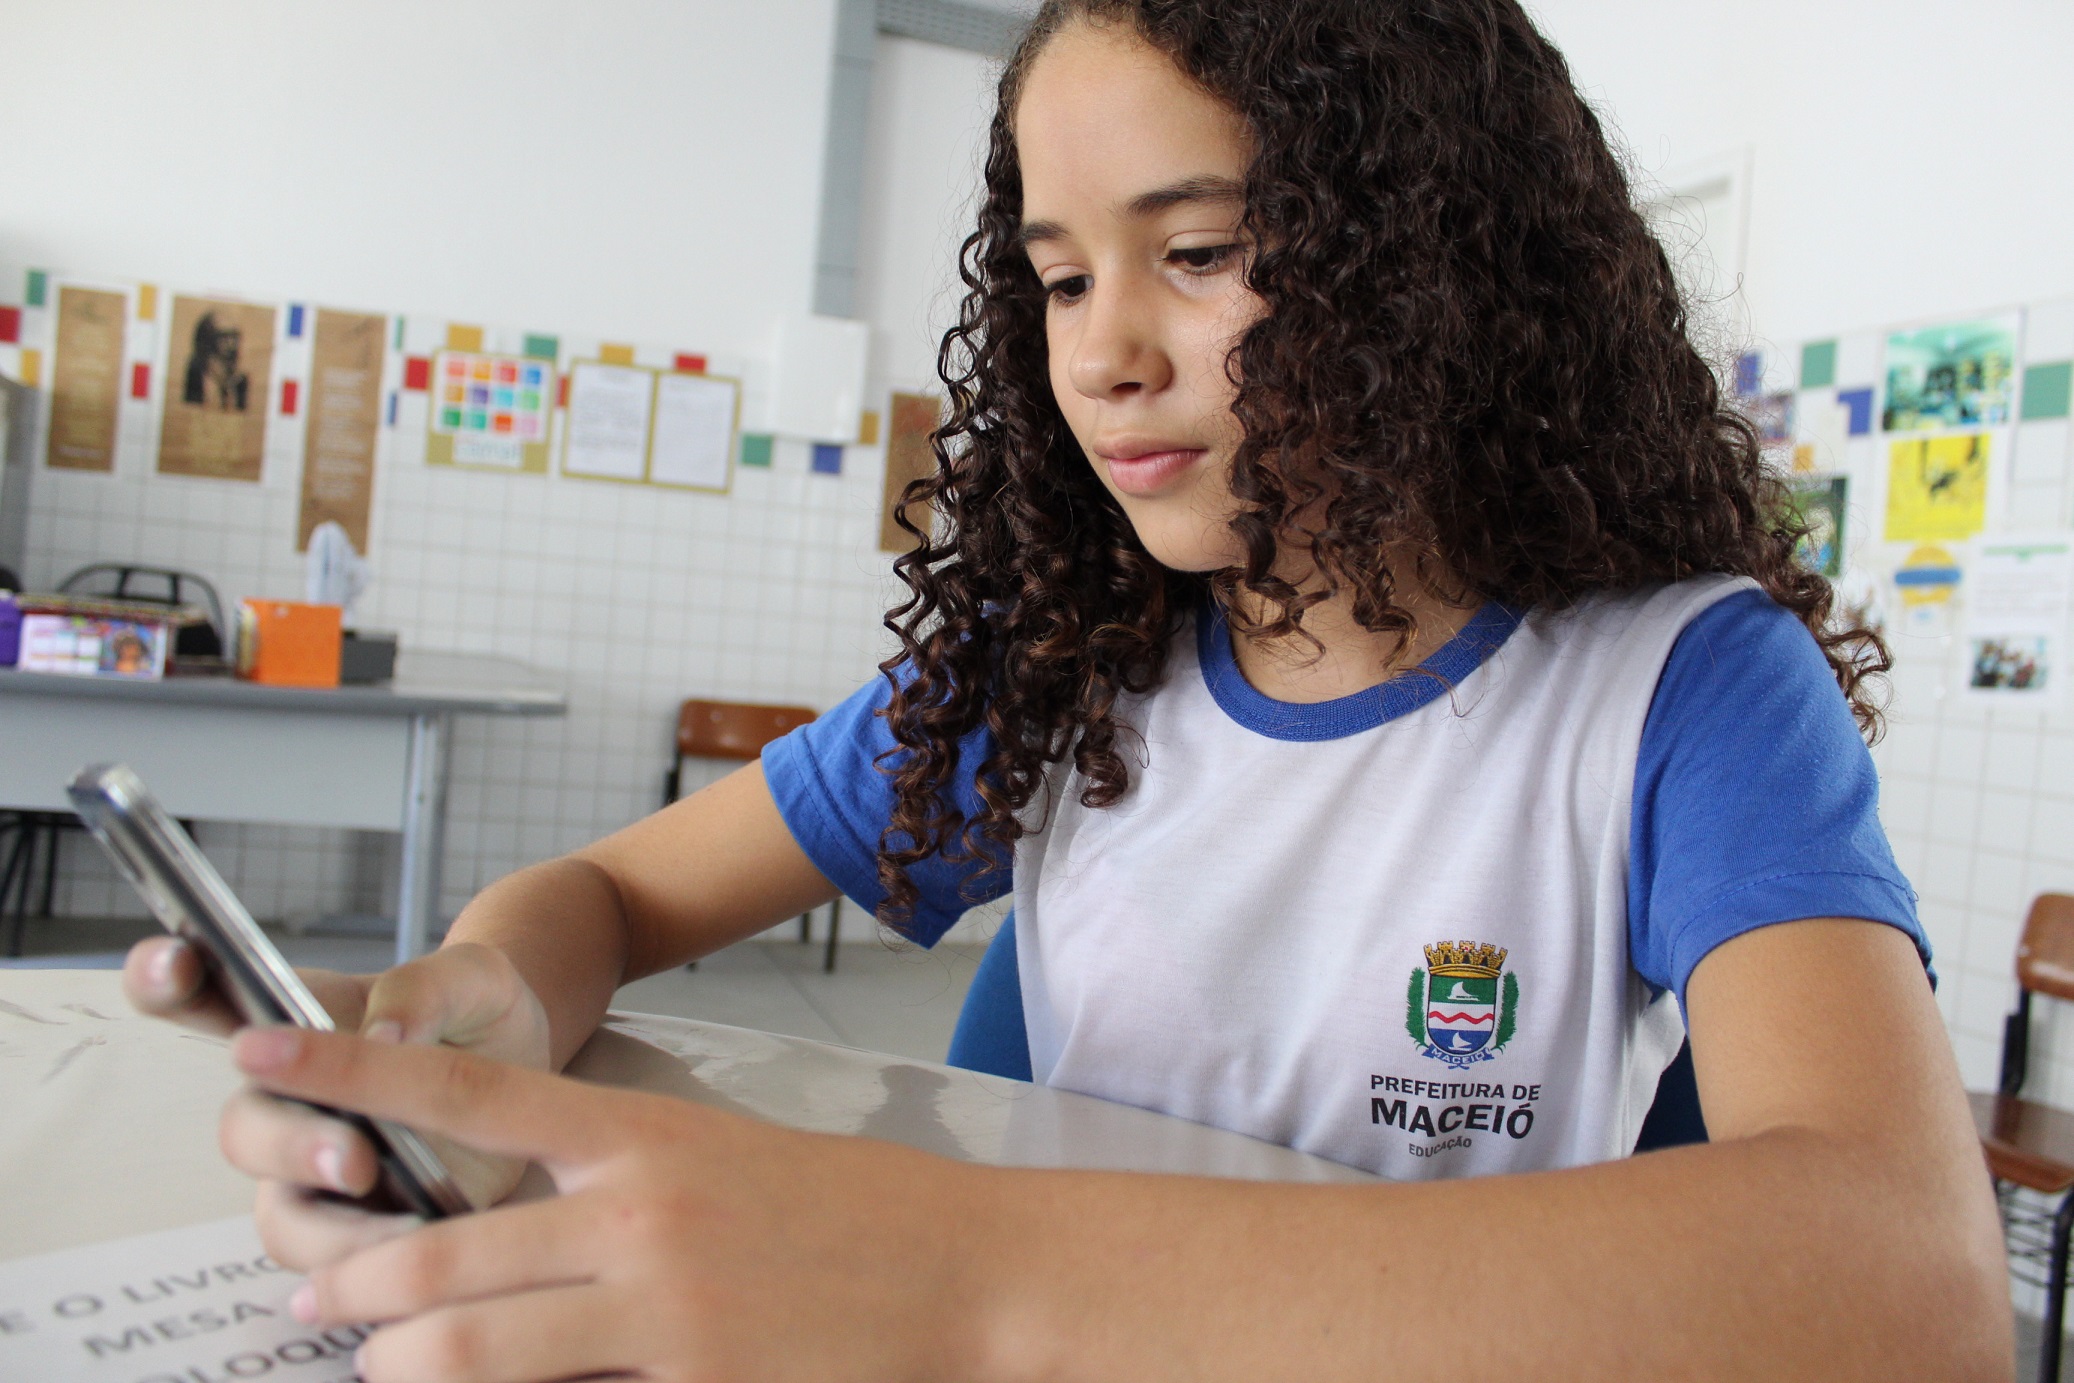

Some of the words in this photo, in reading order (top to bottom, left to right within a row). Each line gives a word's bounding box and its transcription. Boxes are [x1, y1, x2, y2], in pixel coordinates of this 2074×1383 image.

[1371, 1074, 1505, 1100] PREFEITURA
[1512, 1084, 1542, 1101] DE
[1371, 1097, 1534, 1140] MACEIÓ
[1408, 1135, 1472, 1158] EDUCAÇÃO
[53, 1292, 105, 1320] O
[82, 1300, 278, 1359] MESA
